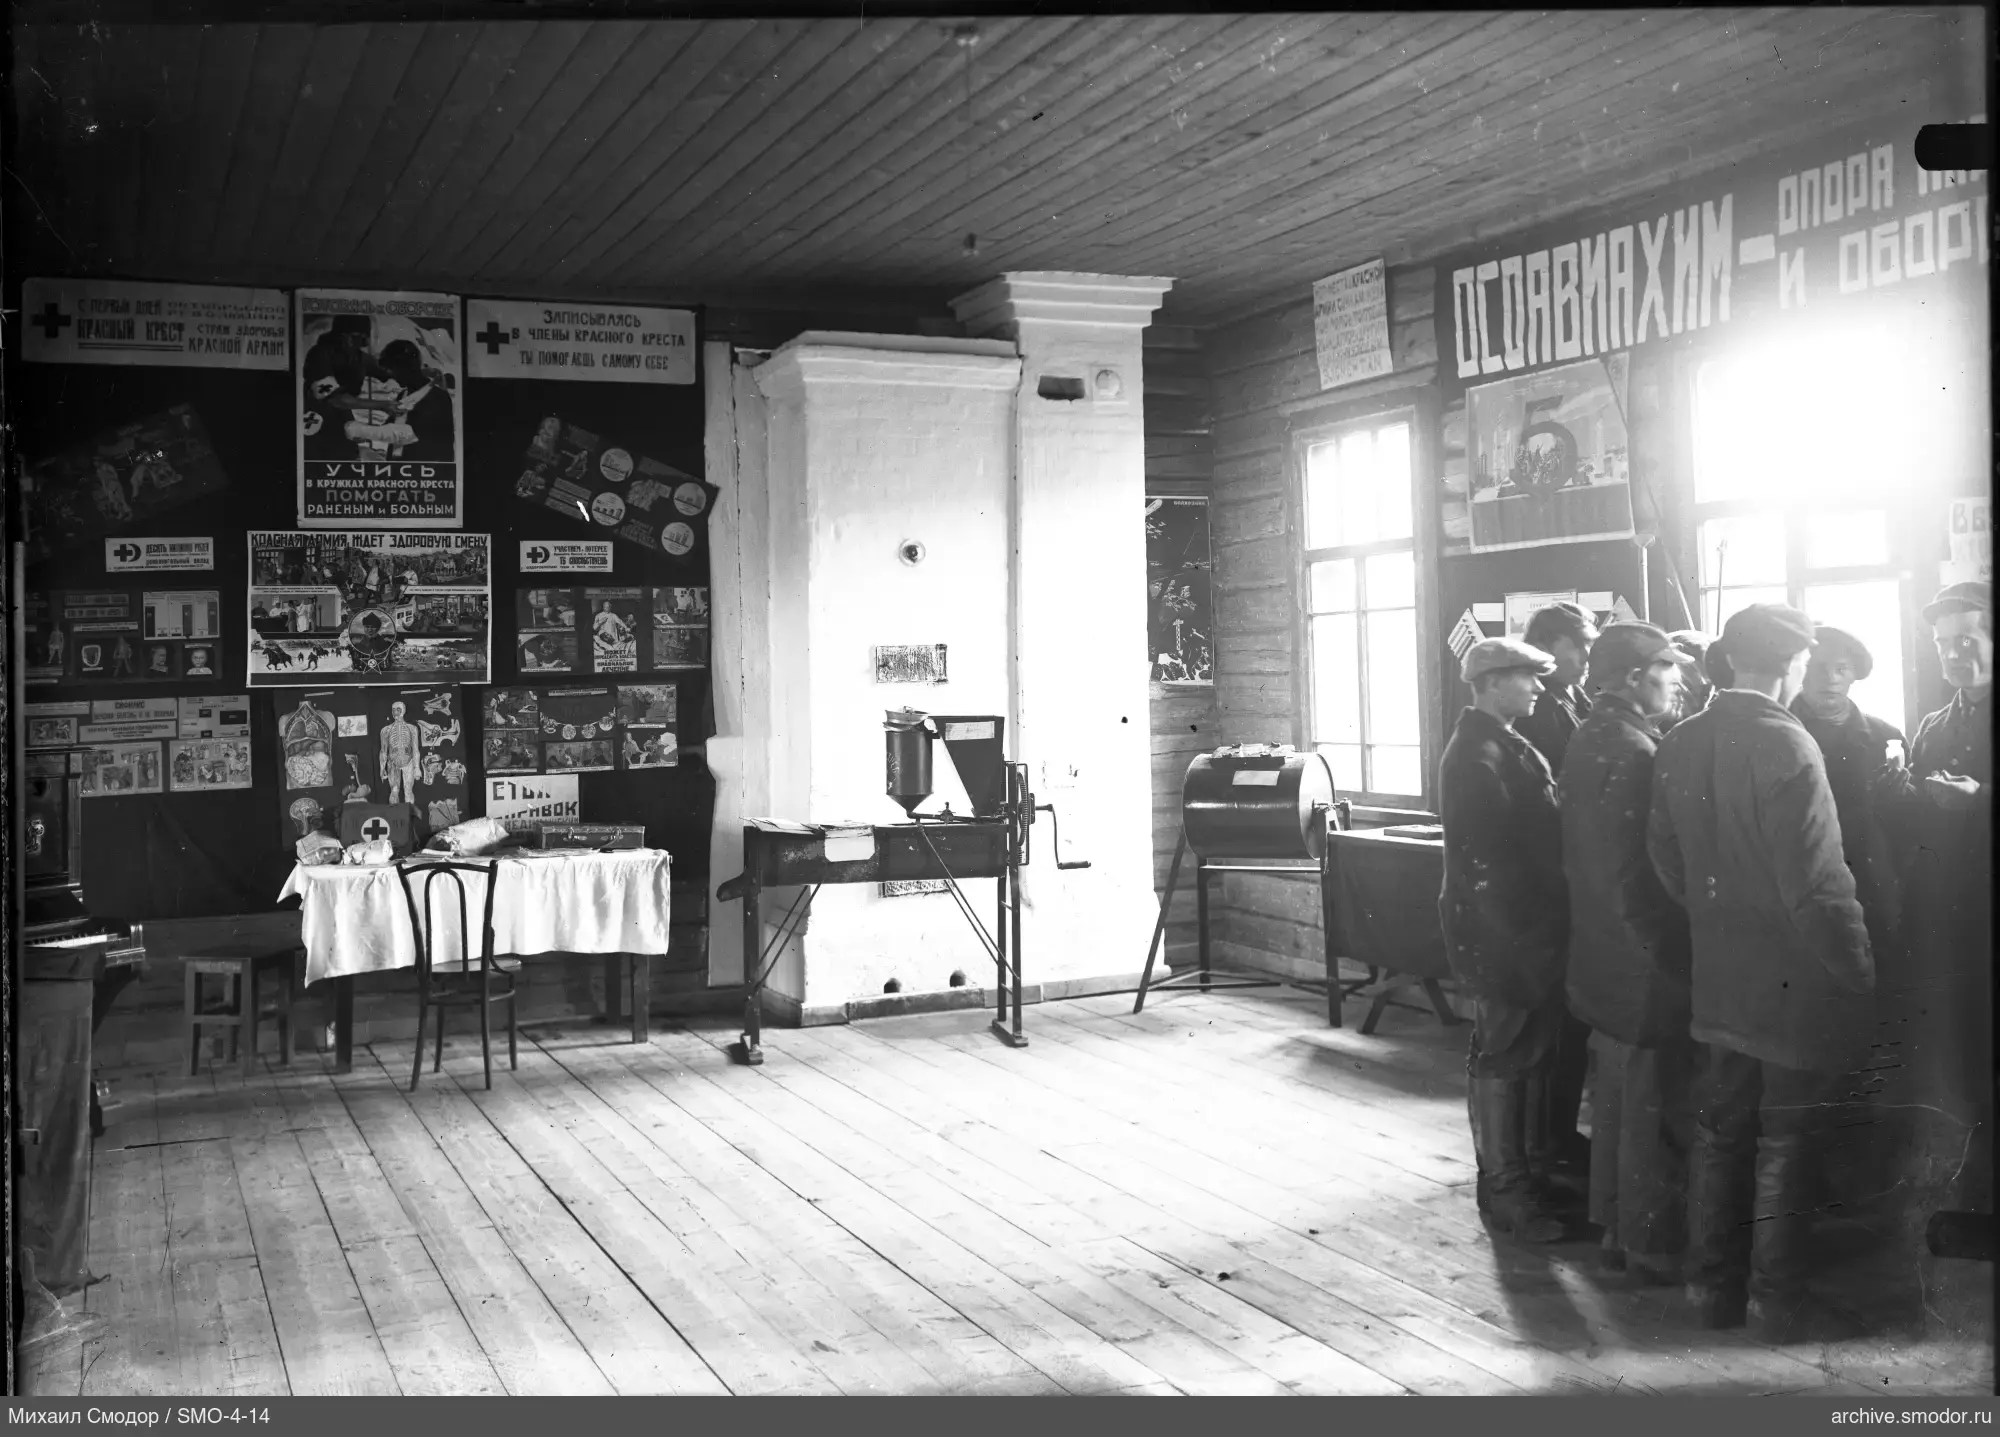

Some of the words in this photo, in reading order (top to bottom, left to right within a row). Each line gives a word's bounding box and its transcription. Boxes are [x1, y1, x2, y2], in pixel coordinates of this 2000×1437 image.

[1778, 143, 1894, 236] ОПОРА
[1453, 193, 1733, 379] ОСОАВИАХИМ
[1779, 247, 1807, 309] И
[301, 298, 375, 314] ГОТОВЯСЬ
[386, 300, 454, 317] ОБОРОНЕ
[543, 310, 642, 328] ЗАПИСЫВАЯСЬ
[77, 319, 135, 341] КРАСНЫЙ
[146, 321, 185, 342] КРЕСТ
[197, 324, 230, 336] СТРАЖ
[236, 325, 285, 338] ЗДОРОВЬЯ
[511, 328, 520, 339] В
[528, 329, 570, 342] ЧЛЕНЫ
[574, 330, 634, 344] КРАСНОГО
[642, 333, 686, 347] КРЕСТА
[189, 336, 240, 355] КРАСНОЙ
[246, 339, 285, 357] АРМИИ
[520, 350, 534, 365] ТЫ
[538, 351, 596, 368] ПОМОГАЕШЬ
[602, 354, 641, 369] САМОМУ
[645, 356, 669, 371] СЕБЕ
[326, 463, 436, 478] УЧИСЬ
[305, 480, 312, 488] В
[317, 479, 364, 489] КРУЖКАХ
[367, 480, 418, 489] КРАСНОГО
[420, 480, 455, 489] КРЕСТА
[326, 490, 436, 502] ПОМОГАТЬ
[307, 504, 374, 515] РАНЕНЫМ
[391, 504, 454, 515] БОЛЬНЫМ
[251, 534, 304, 547] КРАСНАЯ
[308, 535, 347, 547] АРМИЯ
[352, 535, 385, 548] ЖДЕТ
[390, 535, 452, 548] ЗДОРОВУЮ
[455, 535, 488, 549] СМЕНУ
